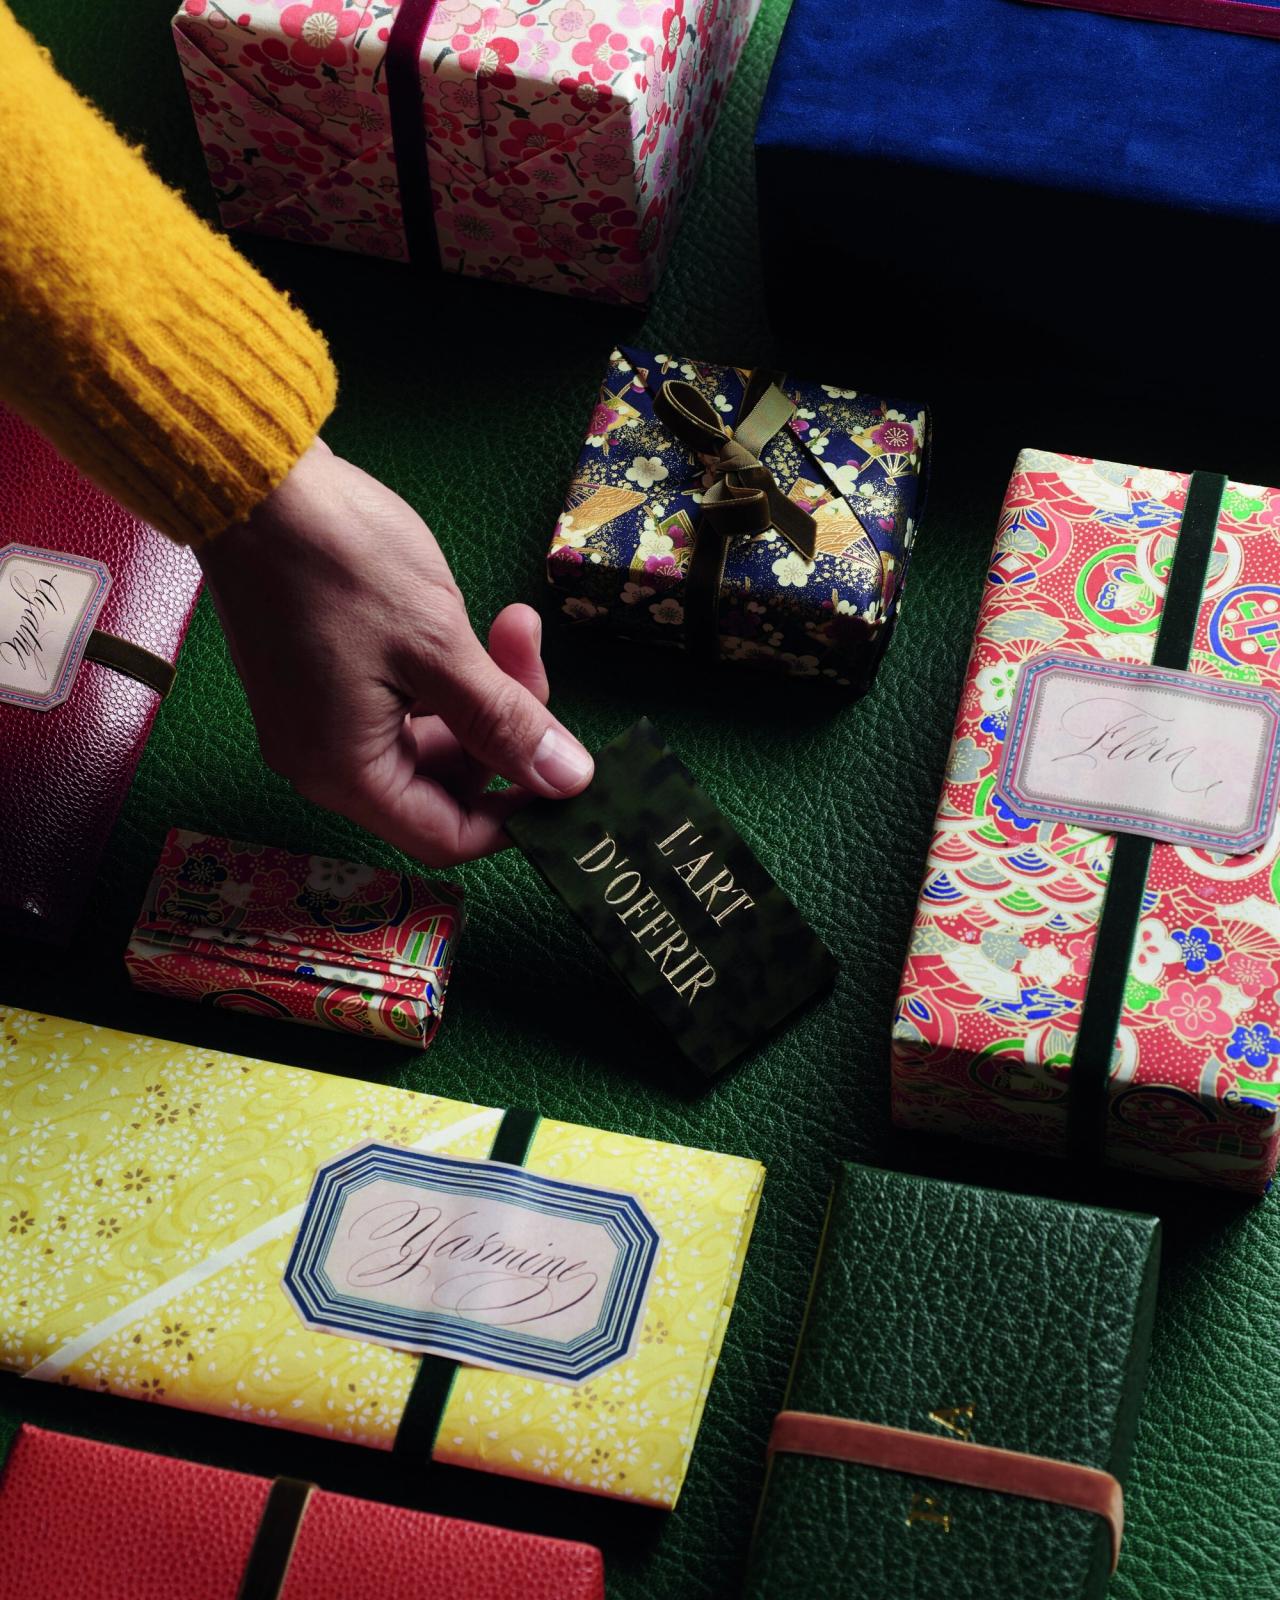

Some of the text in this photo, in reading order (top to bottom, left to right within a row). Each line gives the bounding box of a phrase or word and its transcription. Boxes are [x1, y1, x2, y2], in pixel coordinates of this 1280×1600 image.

[1051, 697, 1223, 799] Flora
[572, 832, 717, 1007] D'OFFRIR
[654, 818, 756, 928] L'ART
[347, 1200, 598, 1326] Yasmine
